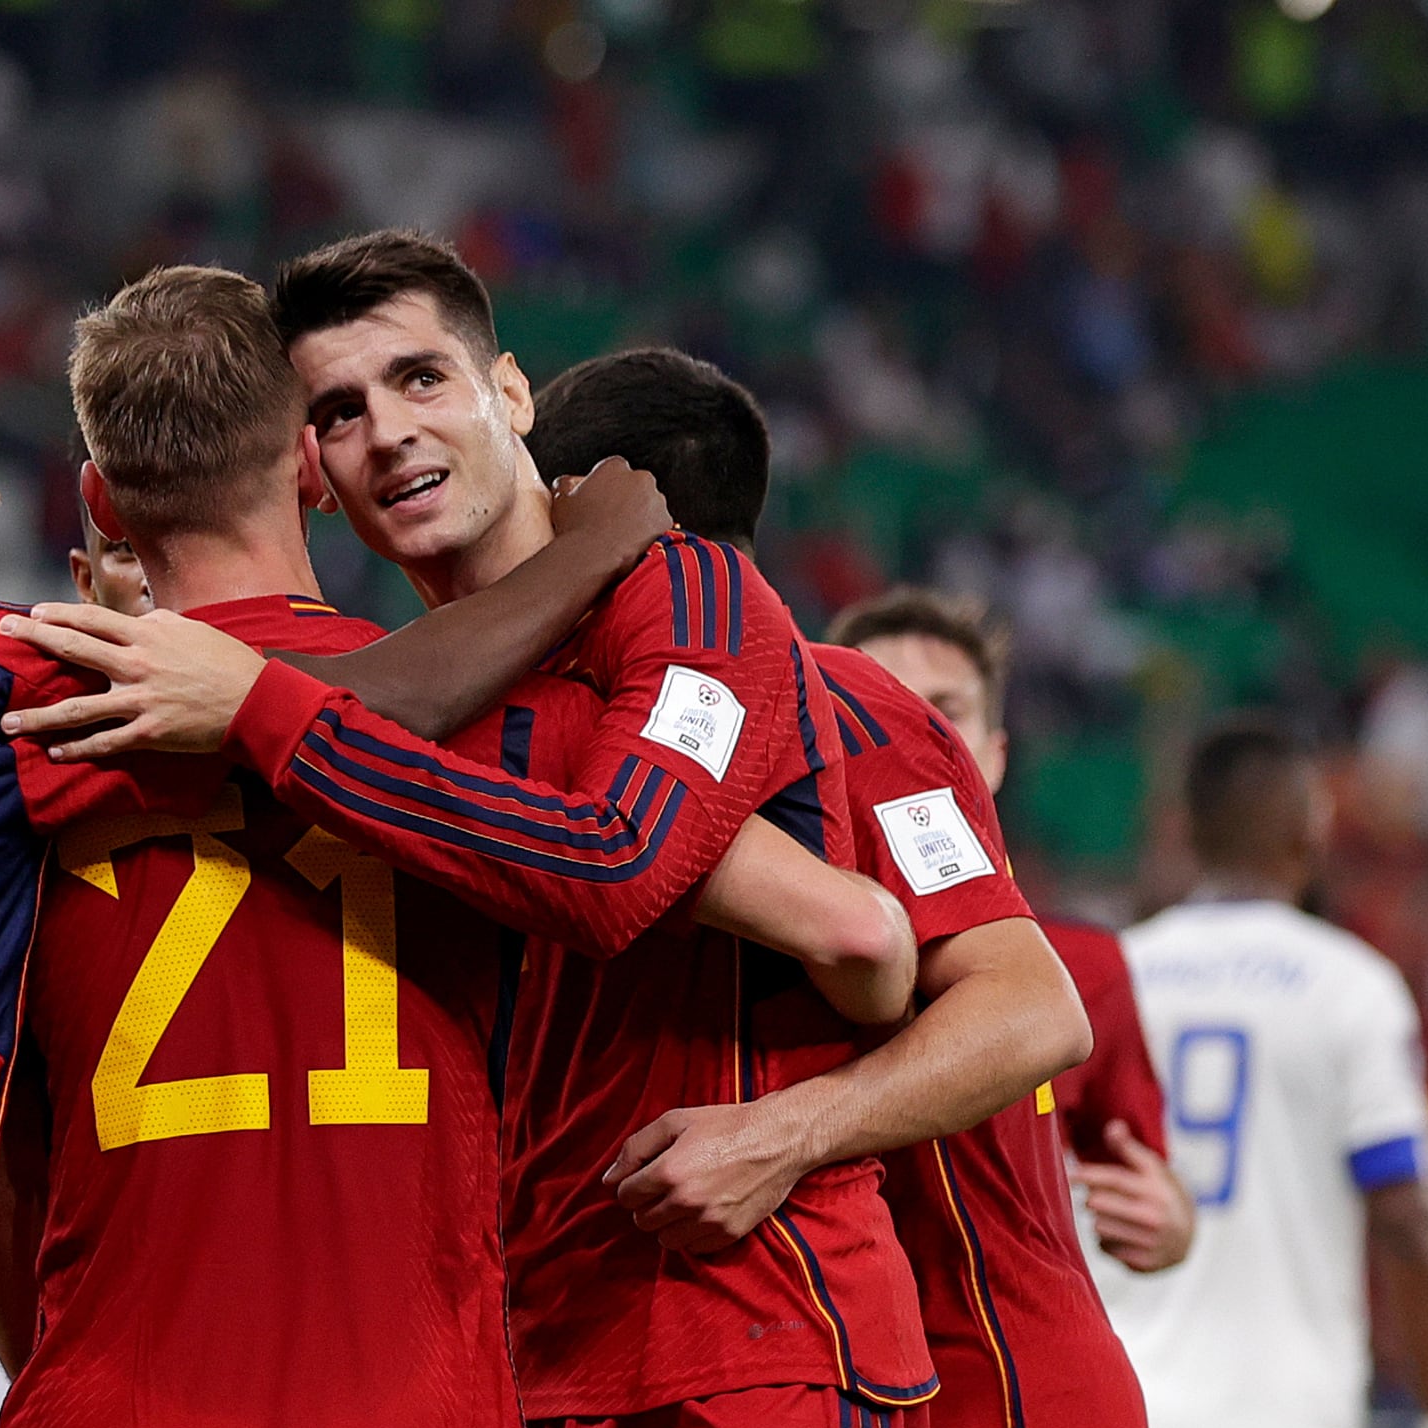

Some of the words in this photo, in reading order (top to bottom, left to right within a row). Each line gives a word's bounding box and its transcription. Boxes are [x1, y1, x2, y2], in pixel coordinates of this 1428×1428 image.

[679, 713, 716, 739] UNITES
[680, 735, 699, 750] FIFA
[918, 837, 956, 858] UNITES
[940, 863, 960, 877] FIFA
[56, 786, 430, 1152] 21
[1170, 1024, 1250, 1209] 9
